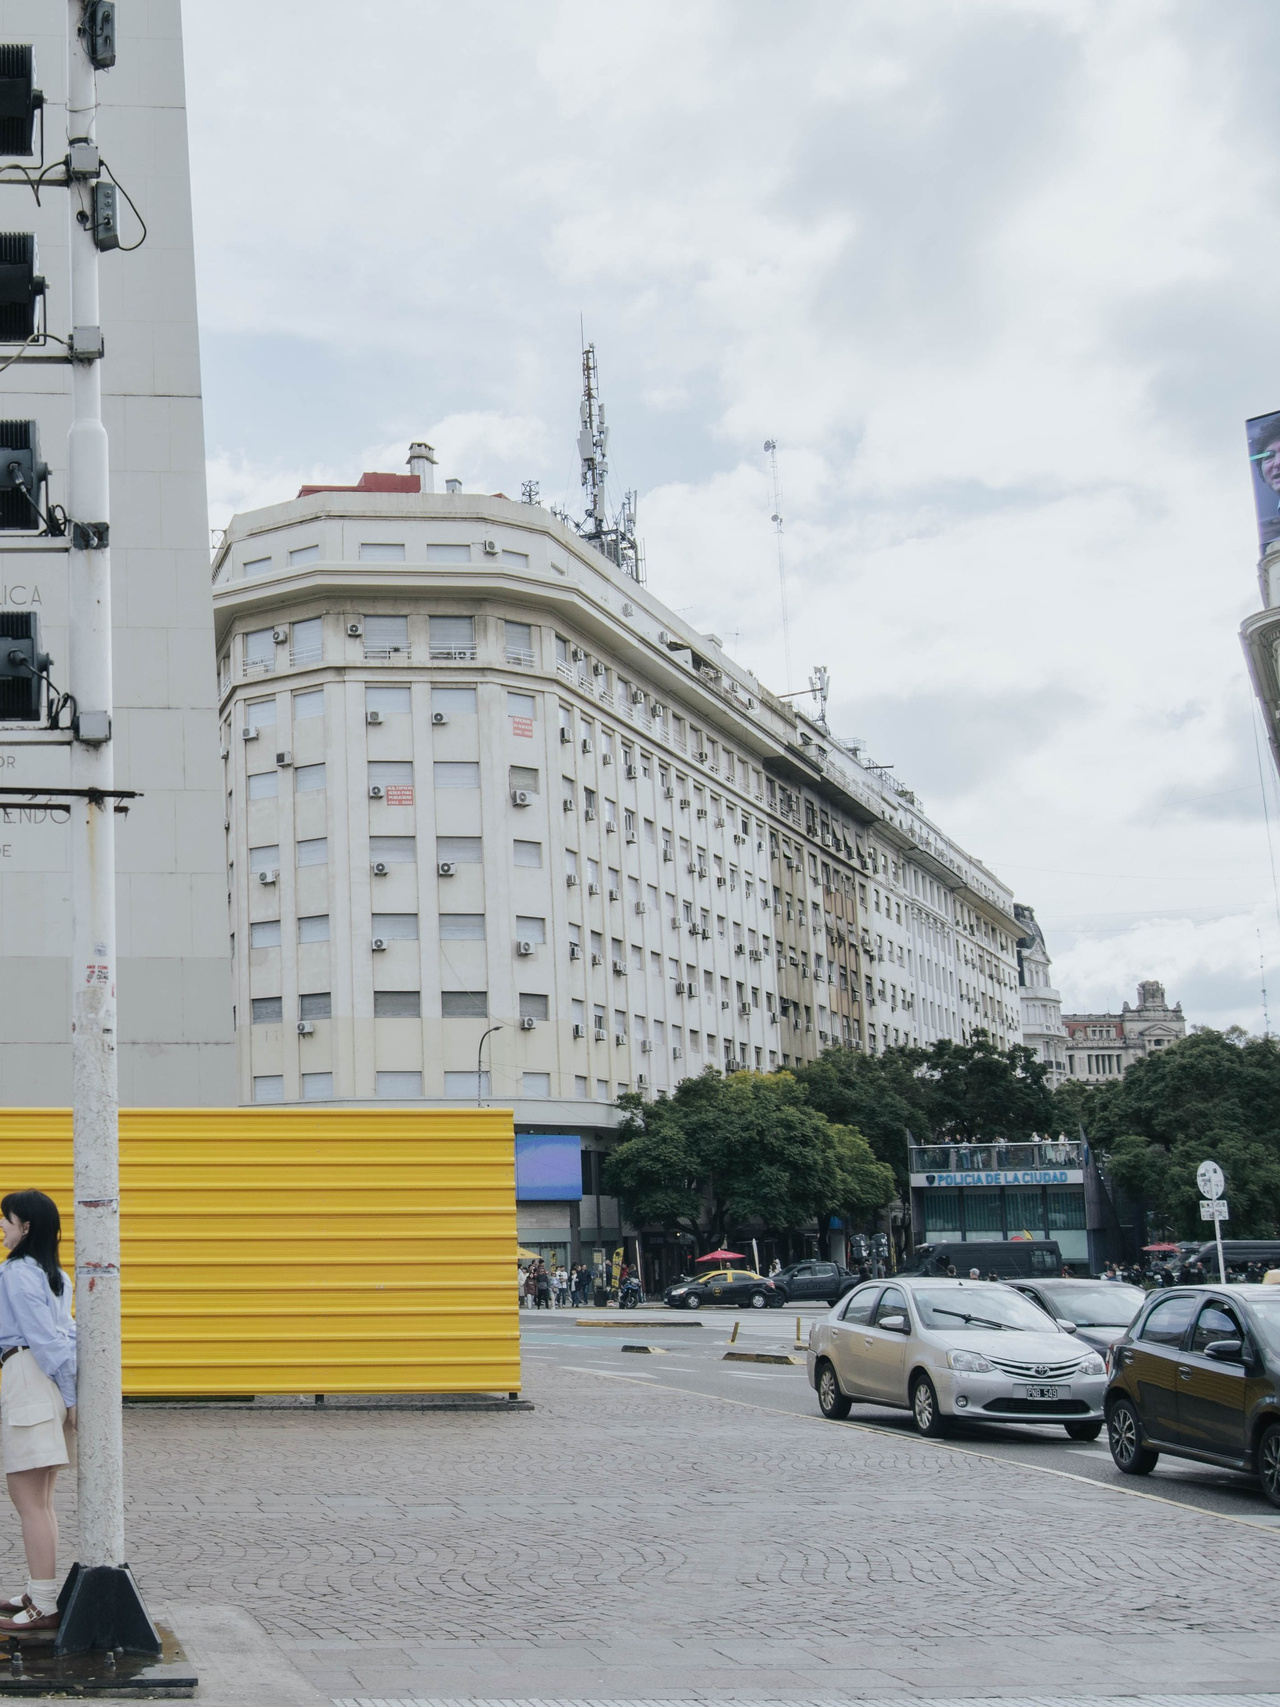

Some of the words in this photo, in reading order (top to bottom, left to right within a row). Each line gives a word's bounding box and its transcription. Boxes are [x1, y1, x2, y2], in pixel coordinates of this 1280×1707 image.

[937, 1173, 983, 1185] POLICIA
[985, 1172, 1001, 1184] DE
[1004, 1172, 1020, 1184] LA
[1022, 1171, 1068, 1183] CIUDAD
[1044, 1389, 1057, 1397] 549
